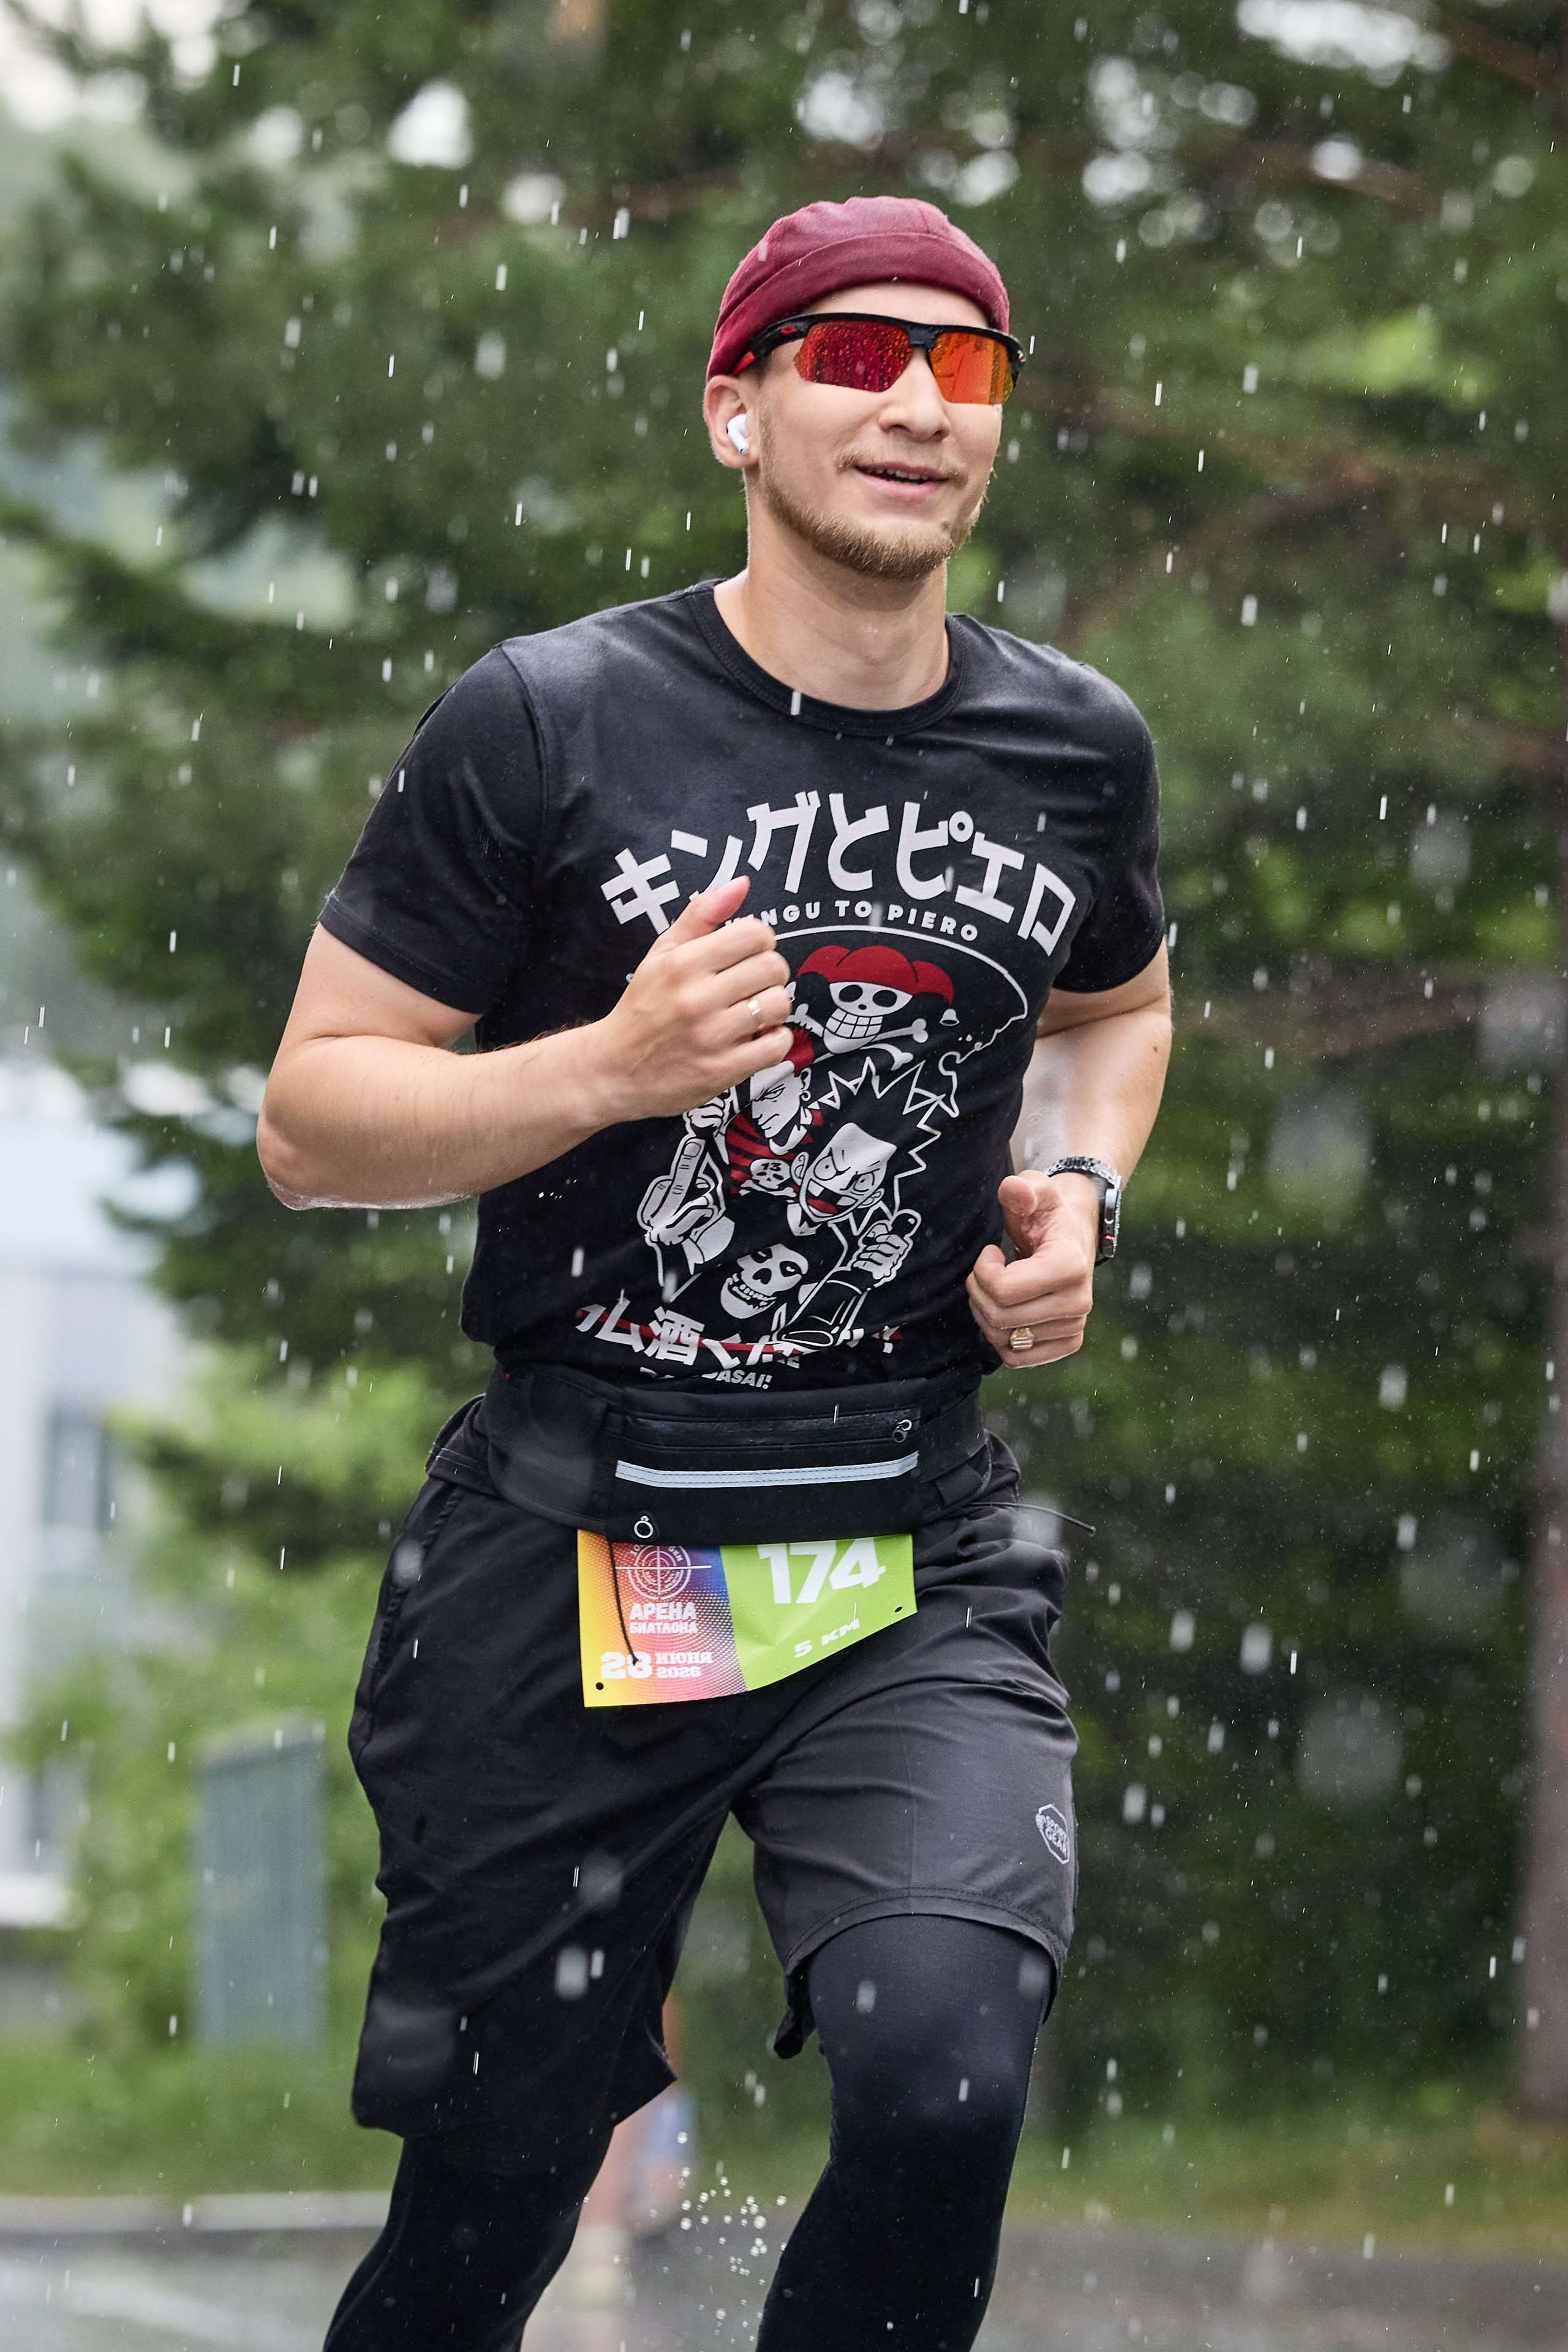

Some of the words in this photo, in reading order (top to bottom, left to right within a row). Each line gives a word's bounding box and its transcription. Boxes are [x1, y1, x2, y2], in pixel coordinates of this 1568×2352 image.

[601, 791, 1076, 957] キングとピエロ
[834, 900, 872, 918] TO
[888, 904, 978, 941] PIERO
[761, 1163, 782, 1172] 13
[757, 1537, 886, 1604] 174
[630, 1602, 697, 1621] АРЕНА
[629, 1622, 698, 1634] БИАТЛОНА
[794, 1640, 813, 1658] 5
[601, 1651, 652, 1679] 28
[655, 1652, 714, 1664] ИЮНЯ
[657, 1666, 701, 1678] 2026
